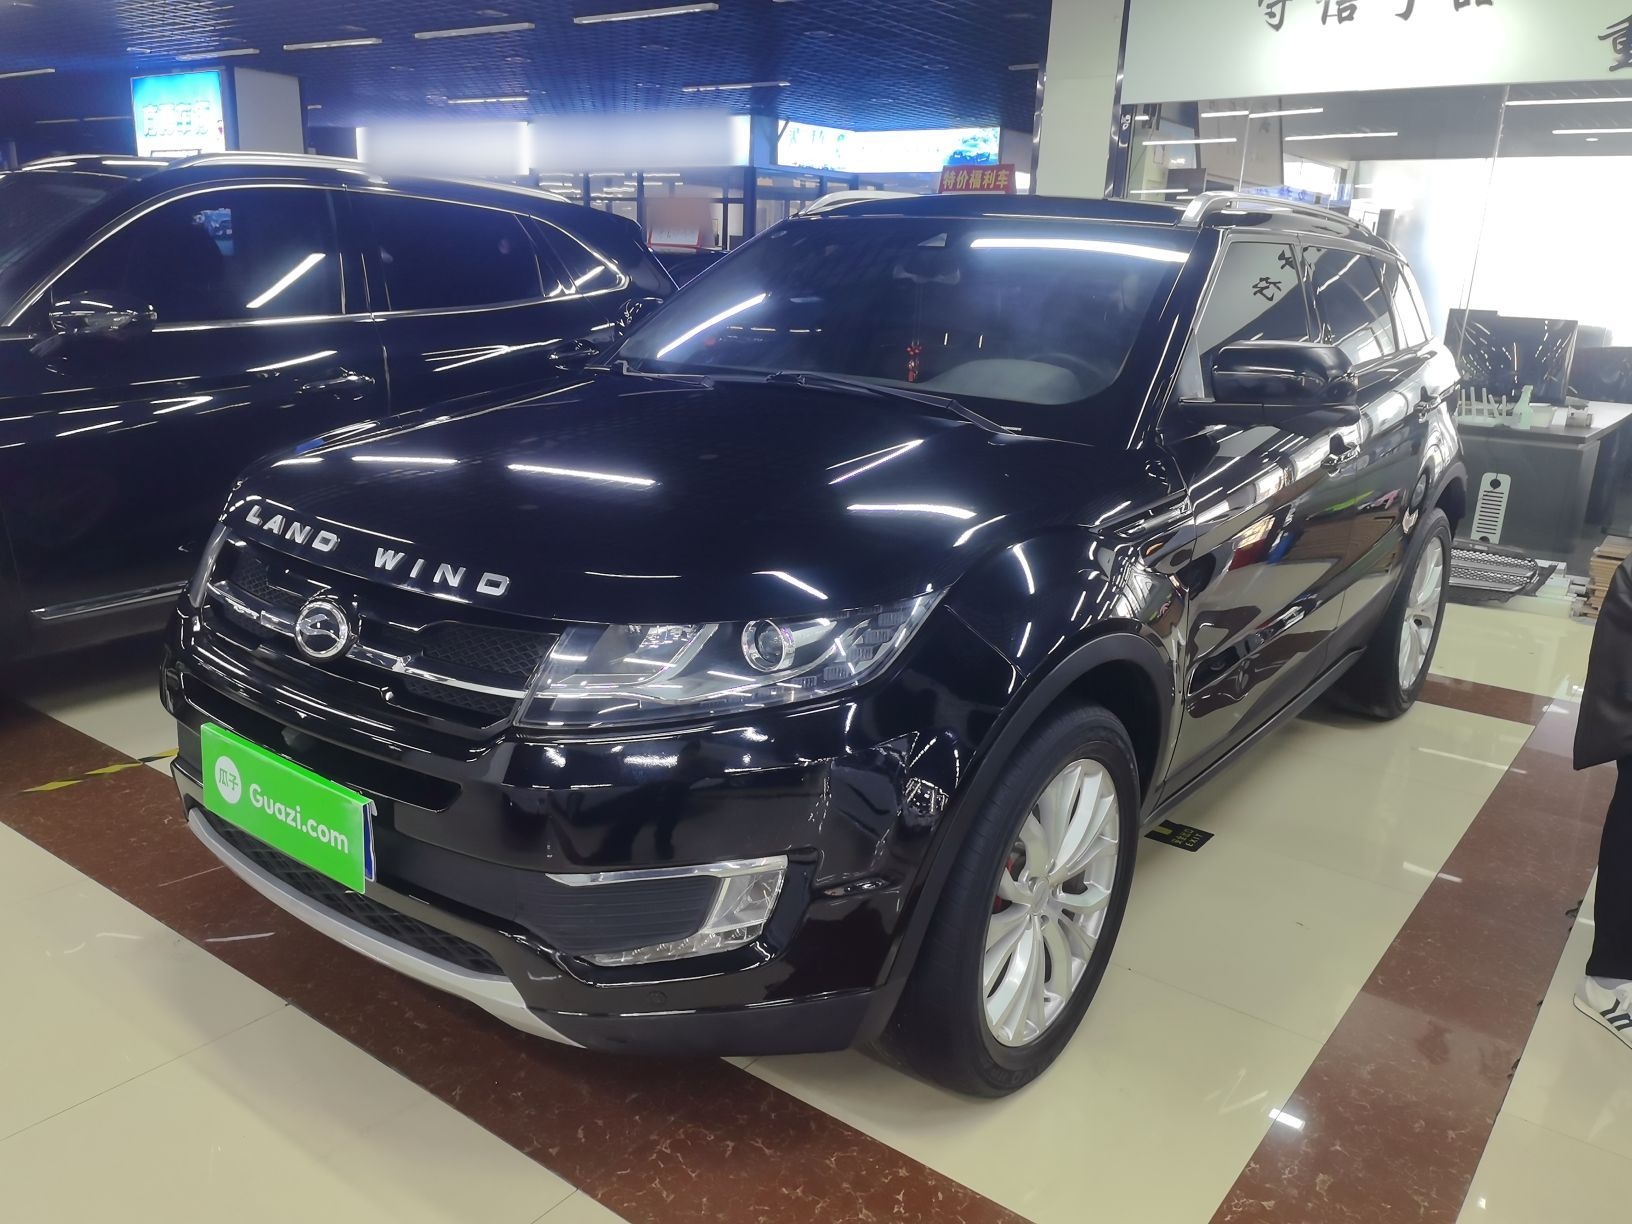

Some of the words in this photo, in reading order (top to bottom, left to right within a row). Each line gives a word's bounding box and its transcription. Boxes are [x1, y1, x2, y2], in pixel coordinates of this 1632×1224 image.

[943, 170, 1009, 189] 特价福利车
[246, 505, 340, 552] LAND
[374, 547, 510, 596] WIND
[218, 767, 239, 792] 瓜子
[249, 783, 349, 854] Guazi.com
[1185, 833, 1202, 846] EXIT
